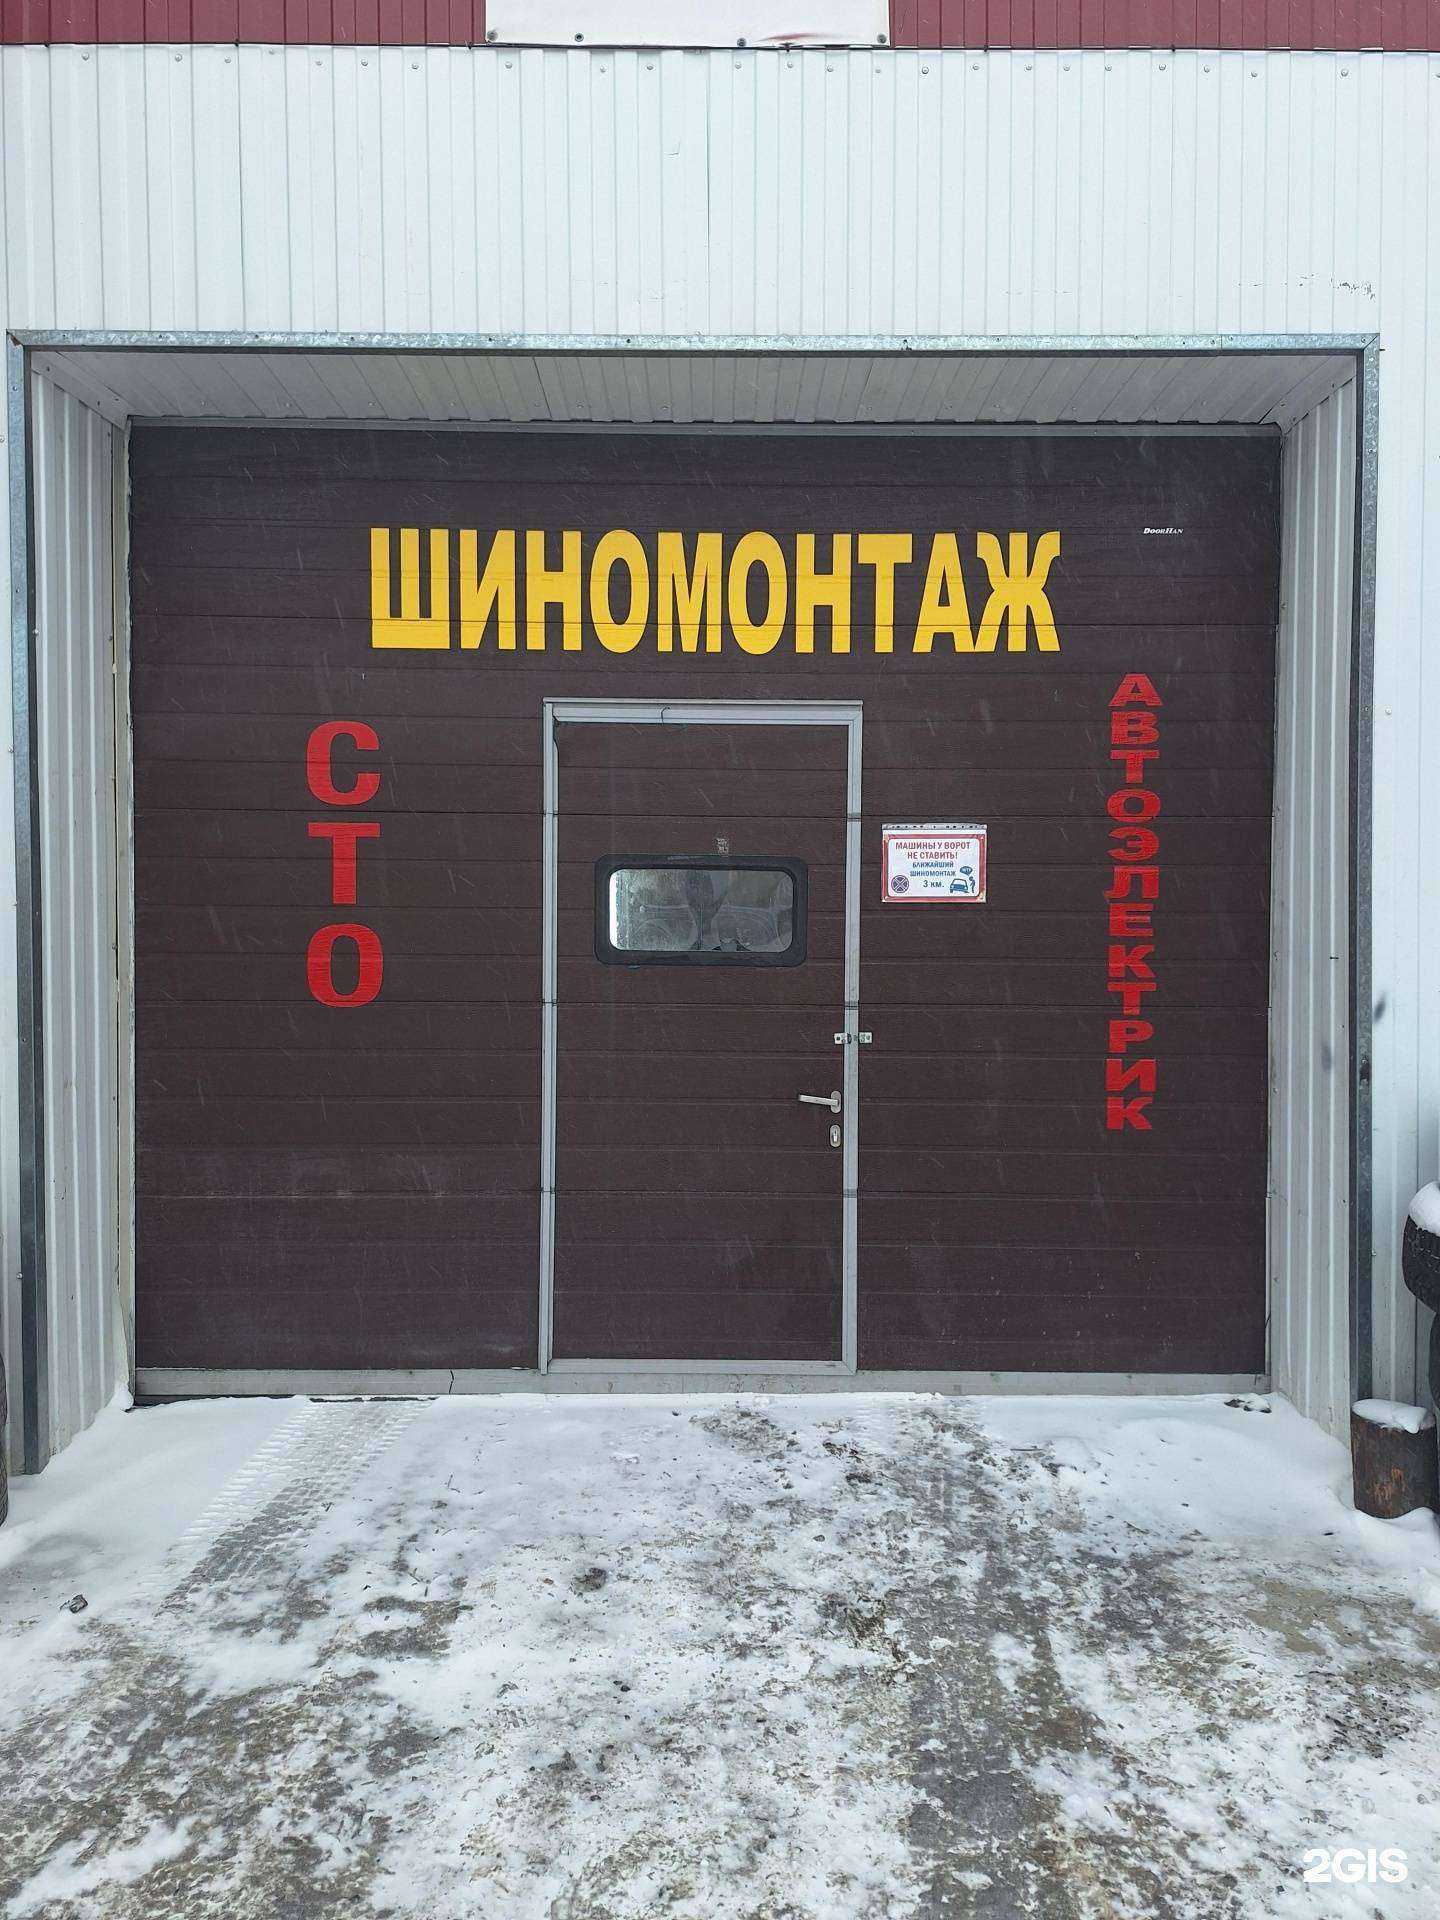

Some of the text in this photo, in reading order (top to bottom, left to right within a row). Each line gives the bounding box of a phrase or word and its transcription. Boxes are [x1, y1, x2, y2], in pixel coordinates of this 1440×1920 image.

[369, 527, 1061, 656] ШИНОМОНТАЖ
[895, 841, 971, 850] МАШИНЫ У ВОРОТ
[907, 851, 958, 860] НЕ СТАВИТЬ!
[305, 720, 384, 1008] СТО
[912, 860, 954, 869] БЛИЖАЙШИЙ
[922, 880, 929, 888] 3
[1104, 672, 1163, 1131] АВТОЭЛЕКТРИК
